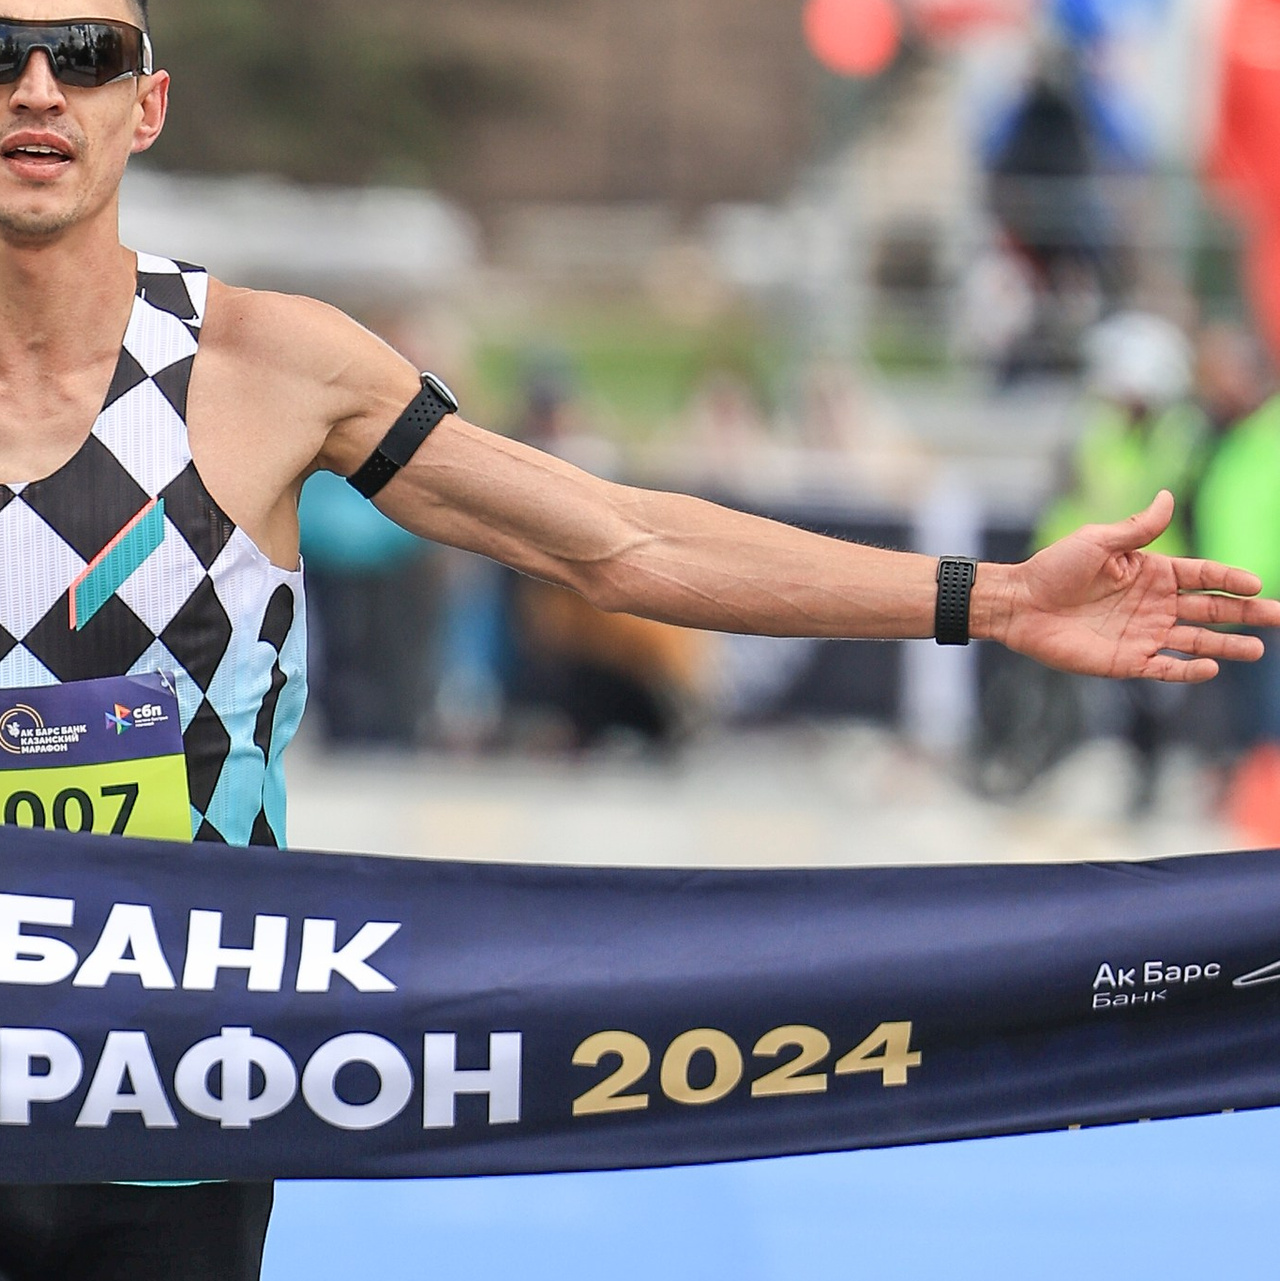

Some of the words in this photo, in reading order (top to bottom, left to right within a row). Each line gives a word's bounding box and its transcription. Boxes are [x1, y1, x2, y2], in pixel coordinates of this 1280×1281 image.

[133, 704, 162, 718] сбп
[20, 728, 34, 737] АК
[35, 727, 60, 736] БАРС
[61, 724, 88, 735] БАНК
[20, 732, 80, 746] КАЗАНСКИЙ
[21, 743, 69, 754] МАРАФОН
[1092, 962, 1136, 990] Ак
[1143, 960, 1222, 985] Барс
[1092, 989, 1168, 1009] Банк
[571, 1020, 922, 1117] 2024
